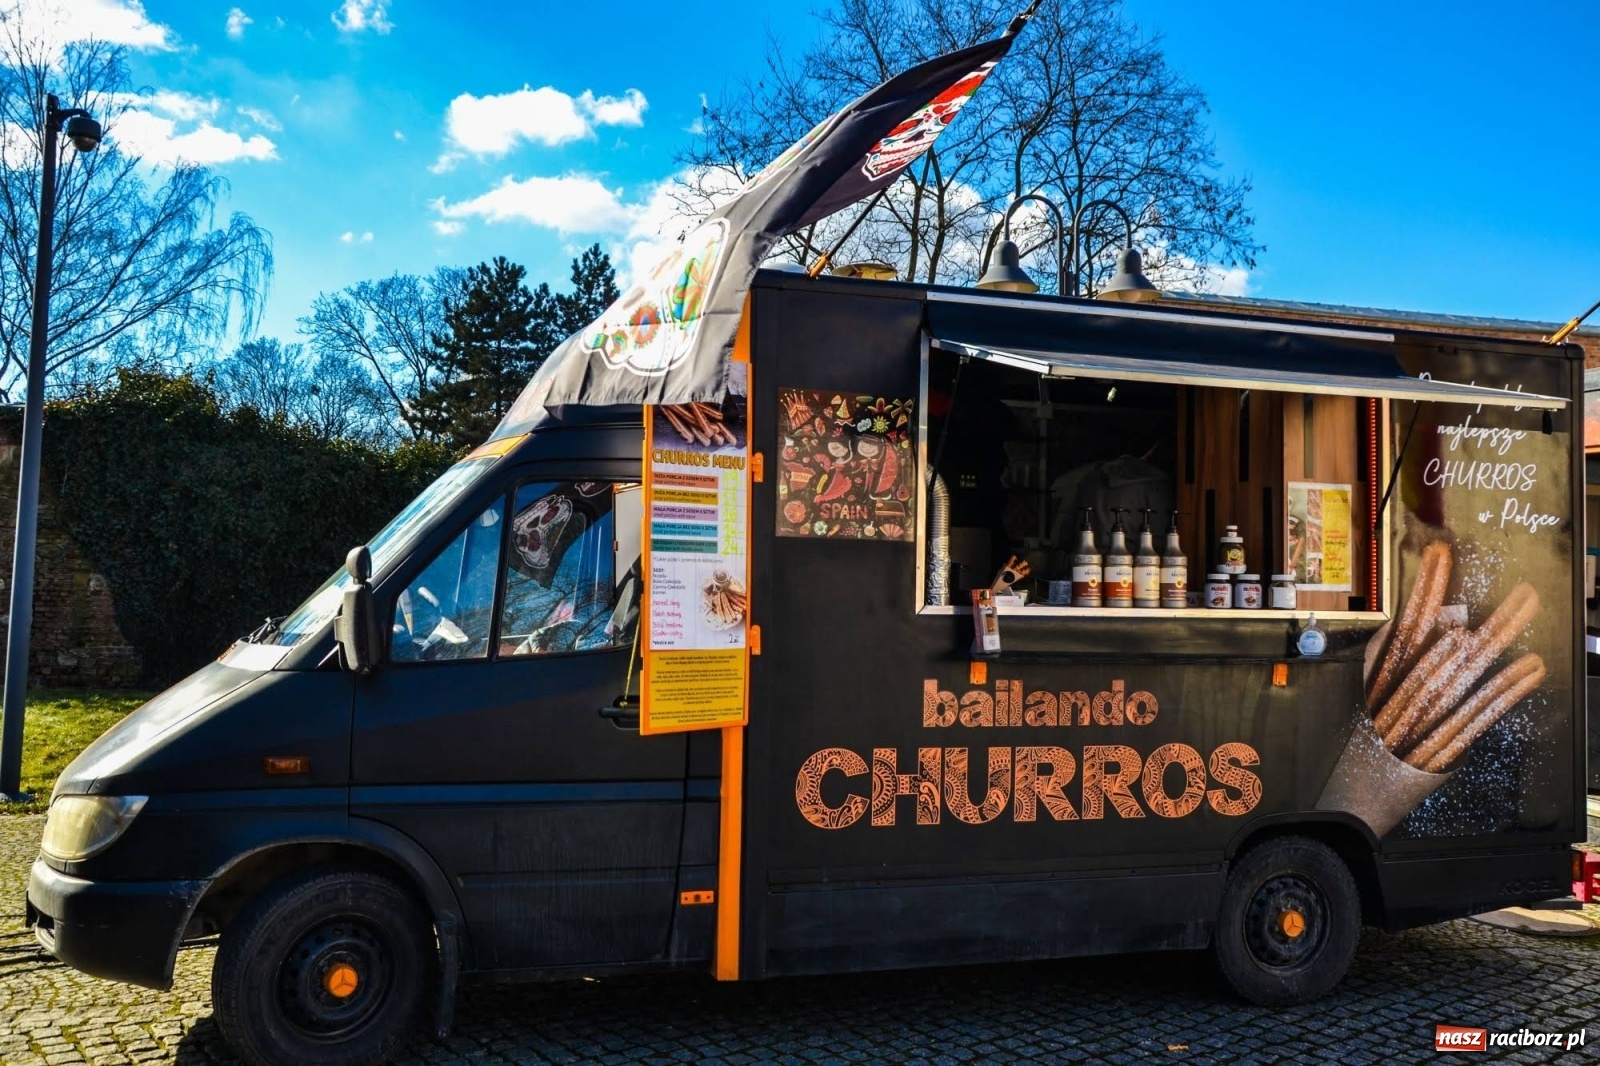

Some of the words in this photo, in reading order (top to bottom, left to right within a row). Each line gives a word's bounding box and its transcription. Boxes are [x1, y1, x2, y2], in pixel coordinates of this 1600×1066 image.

[1437, 415, 1527, 455] najlepsze
[652, 449, 710, 467] CHURROS
[712, 454, 746, 470] MENU
[1423, 458, 1537, 491] CHURROS
[820, 502, 868, 520] SPAIN
[1478, 510, 1494, 524] w
[1500, 497, 1561, 534] Polsce
[923, 679, 1158, 727] bailando
[795, 742, 1263, 829] CHURROS
